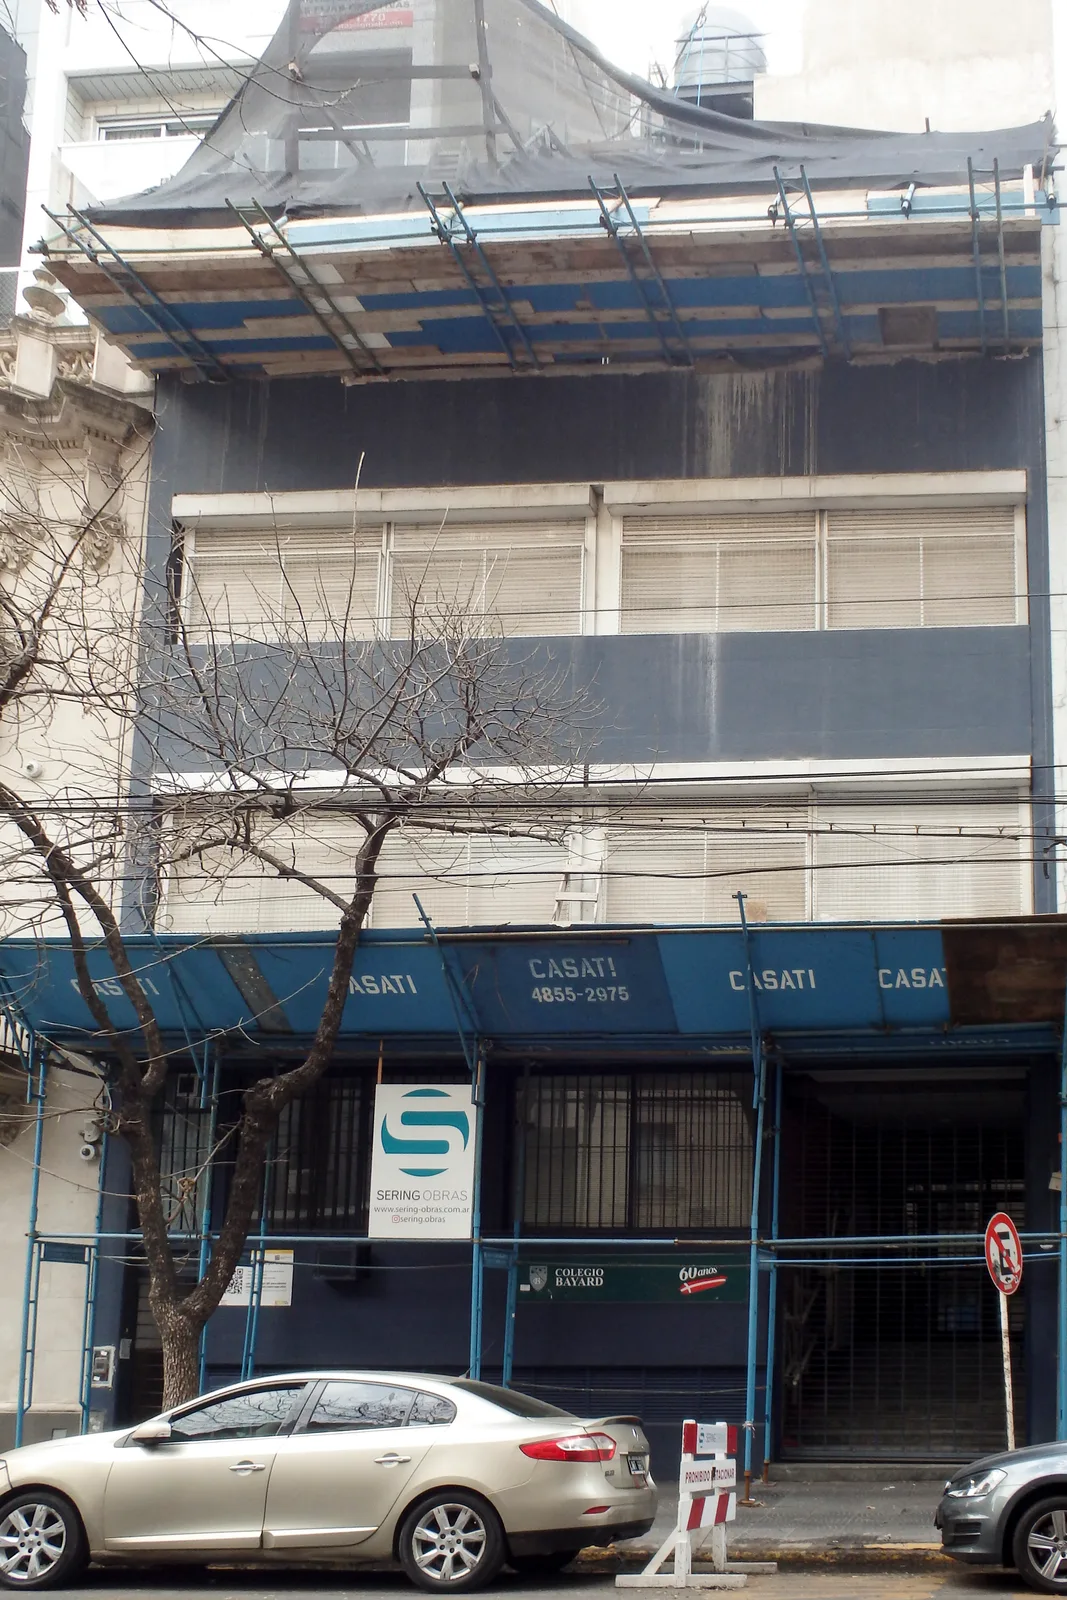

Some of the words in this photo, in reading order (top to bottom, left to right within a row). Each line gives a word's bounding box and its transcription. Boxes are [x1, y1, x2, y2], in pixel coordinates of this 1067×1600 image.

[878, 967, 947, 989] CASA
[329, 975, 418, 995] ASATI
[531, 986, 629, 1003] 4855-2975
[376, 1189, 421, 1201] SERING
[422, 1189, 468, 1202] OBRAS
[373, 1205, 470, 1215] www.sering-obras.com.ar
[400, 1215, 446, 1224] sering.obras
[555, 1268, 604, 1277] COLEGIO
[679, 1267, 698, 1281] 60
[555, 1277, 604, 1287] BAYARD
[685, 1470, 711, 1484] PROHIBIDO
[711, 1467, 735, 1482] TACIONAR
